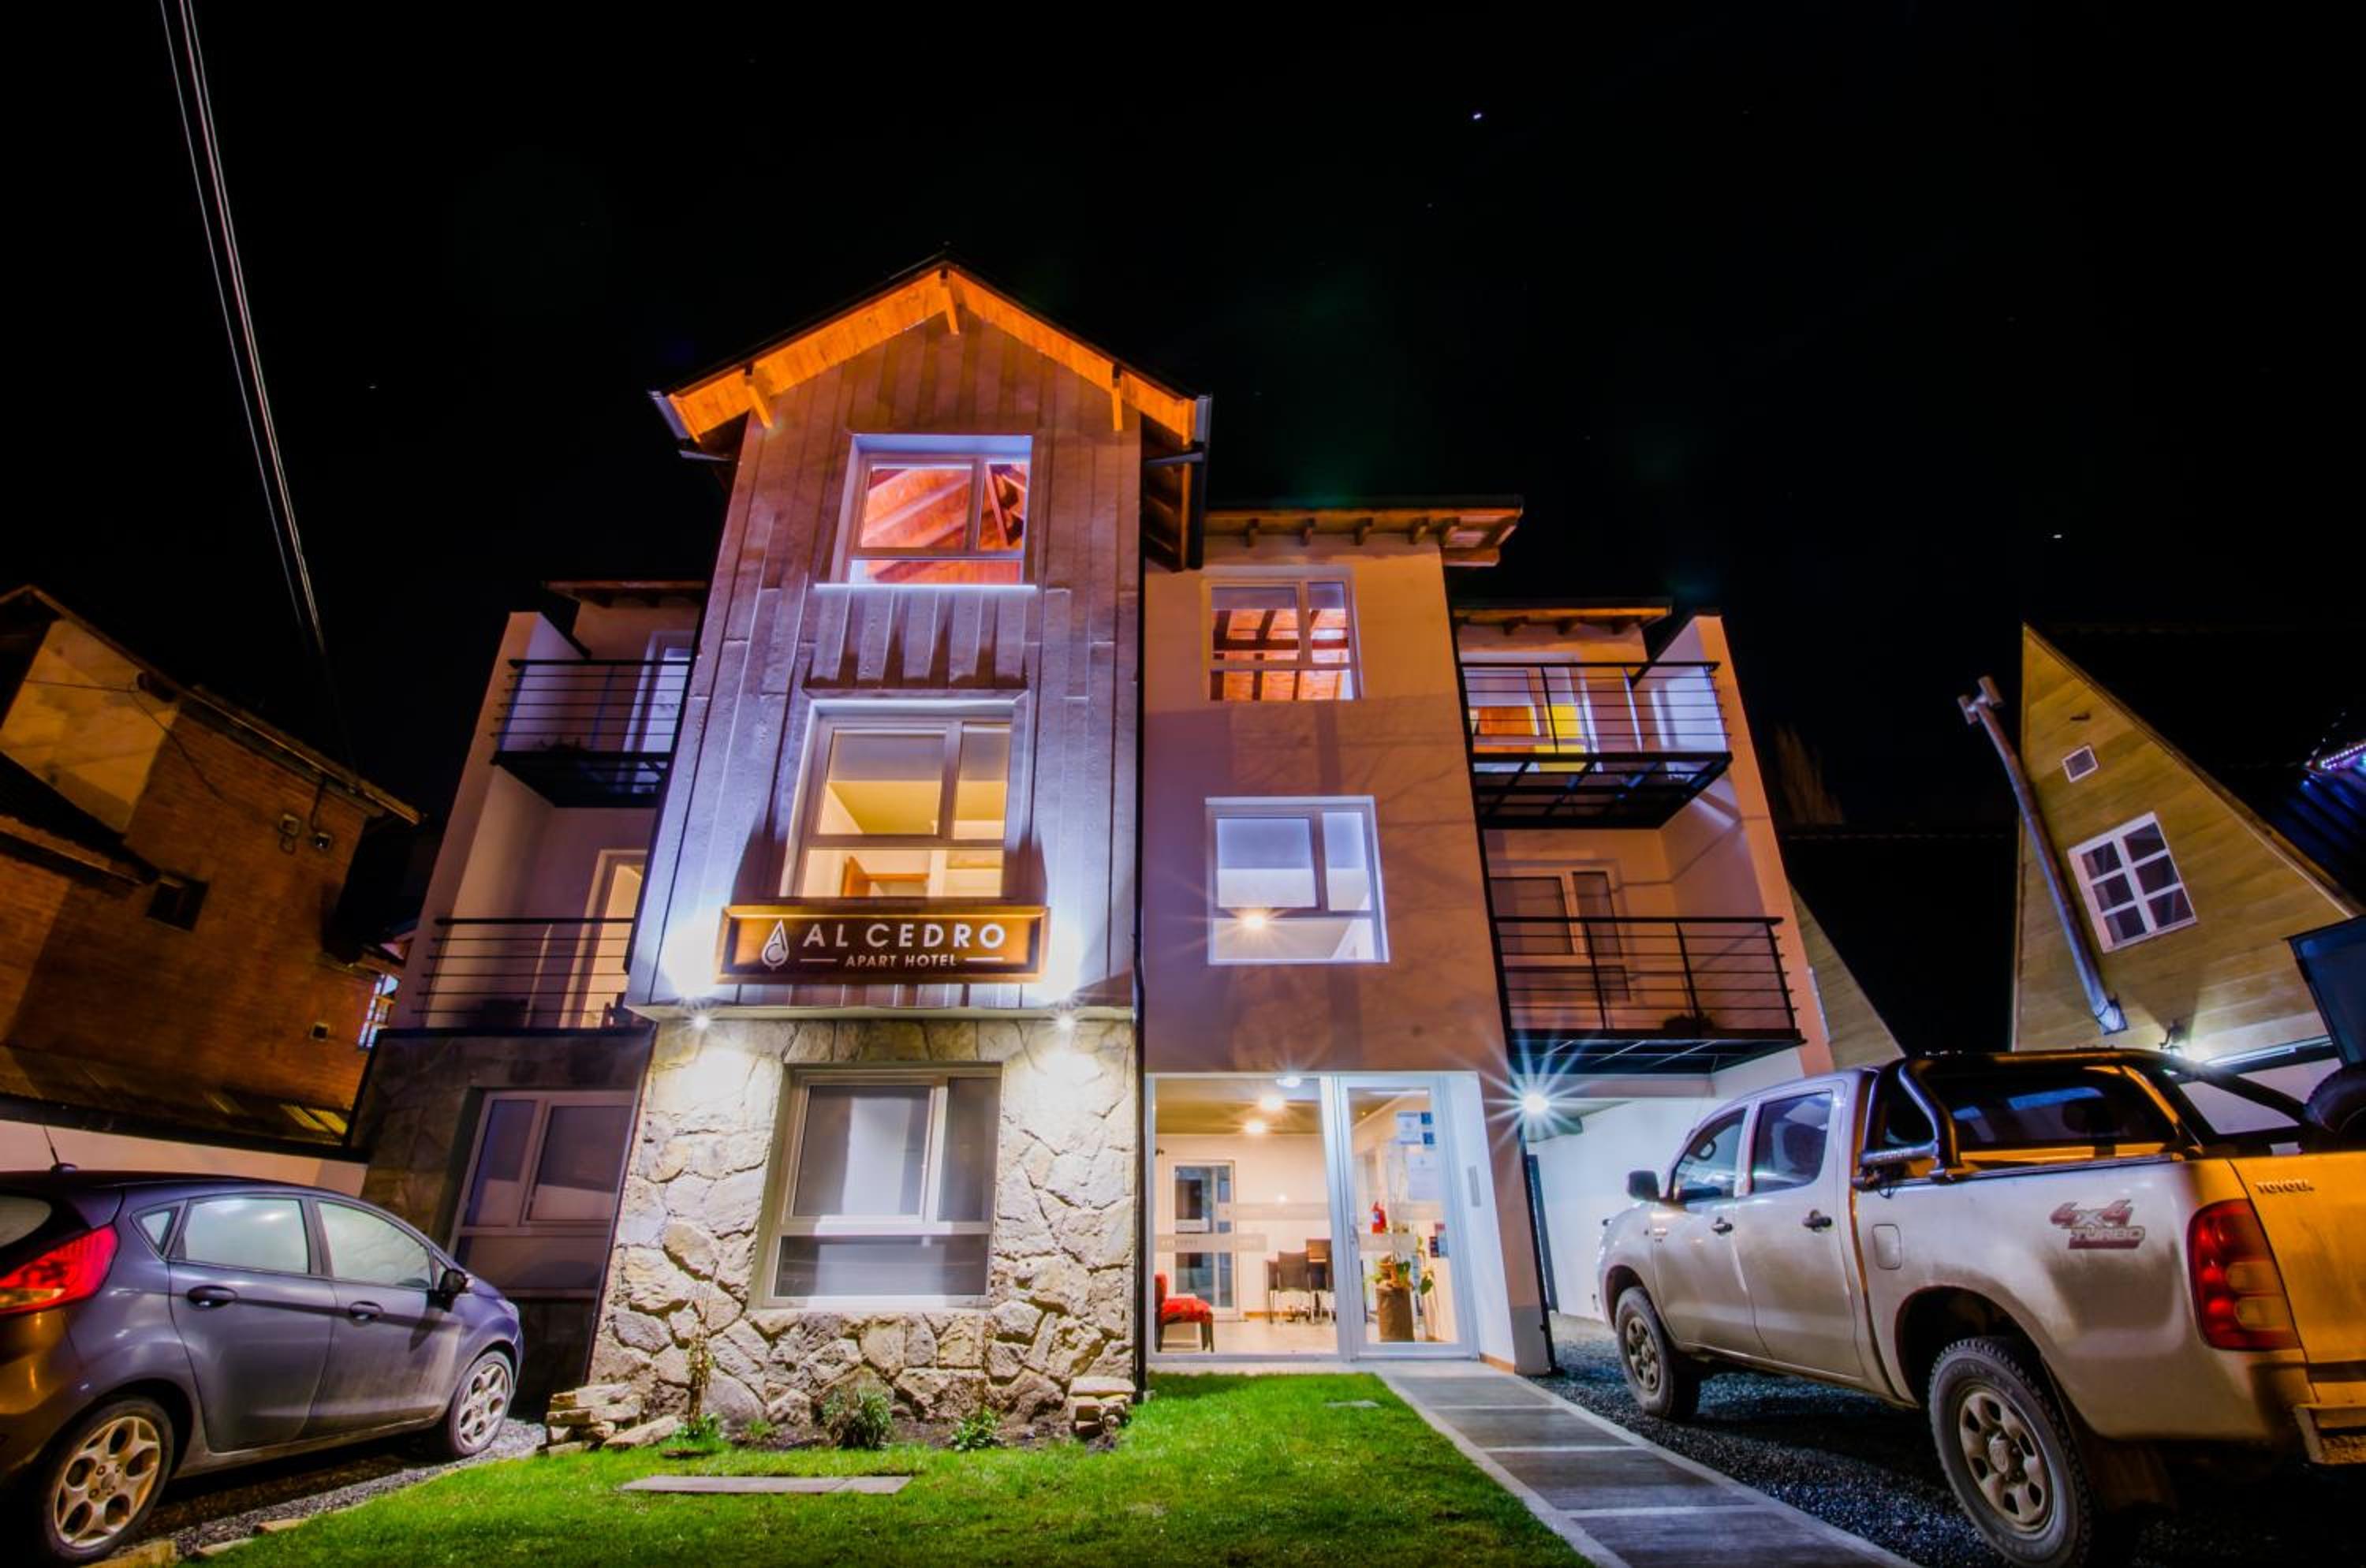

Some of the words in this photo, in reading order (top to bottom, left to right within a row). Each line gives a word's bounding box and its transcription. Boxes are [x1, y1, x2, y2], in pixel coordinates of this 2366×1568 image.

[802, 923, 849, 947] AL
[865, 922, 1006, 949] CEDRO
[845, 954, 898, 967] APART
[905, 954, 957, 967] HOTEL
[2069, 1224, 2146, 1242] TURBO
